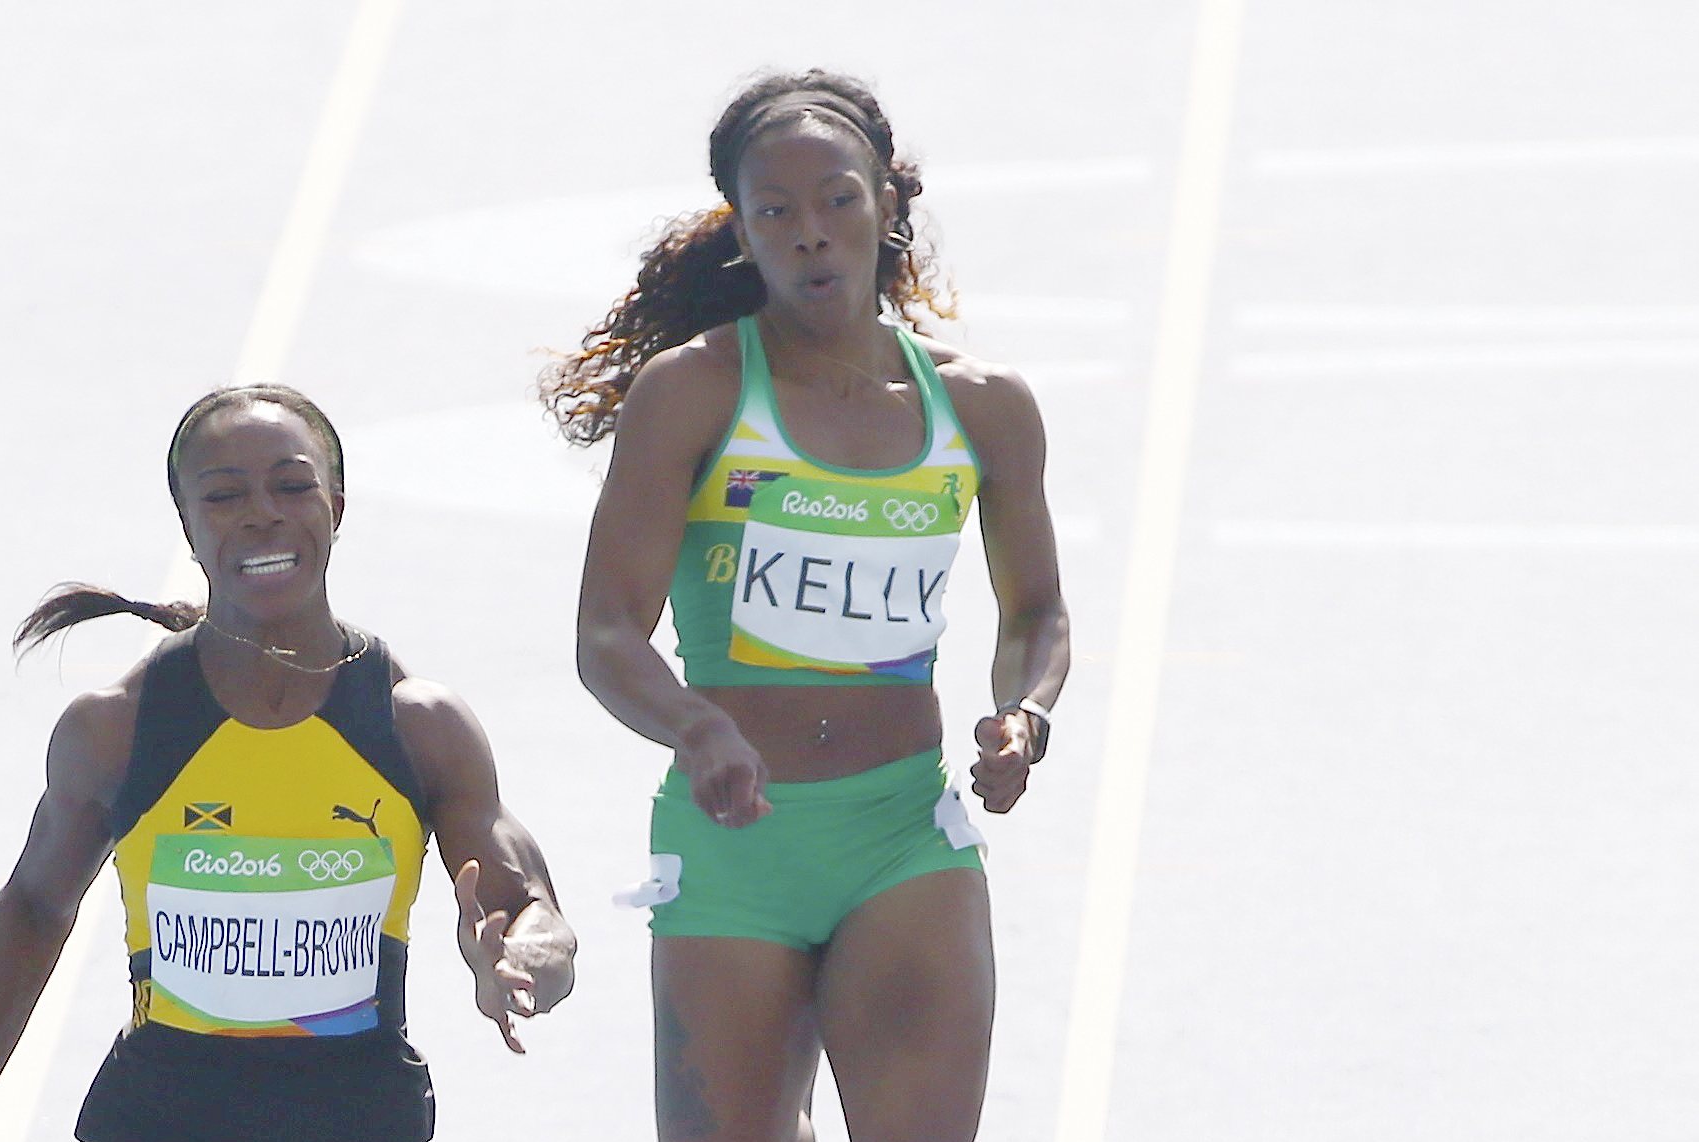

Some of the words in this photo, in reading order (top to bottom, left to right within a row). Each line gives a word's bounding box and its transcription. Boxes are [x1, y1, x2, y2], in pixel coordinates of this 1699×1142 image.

[781, 490, 869, 522] Rio2016
[741, 547, 946, 624] KELLY
[183, 848, 282, 877] Rio2016
[156, 911, 381, 977] CAMPBELL-BROWN
